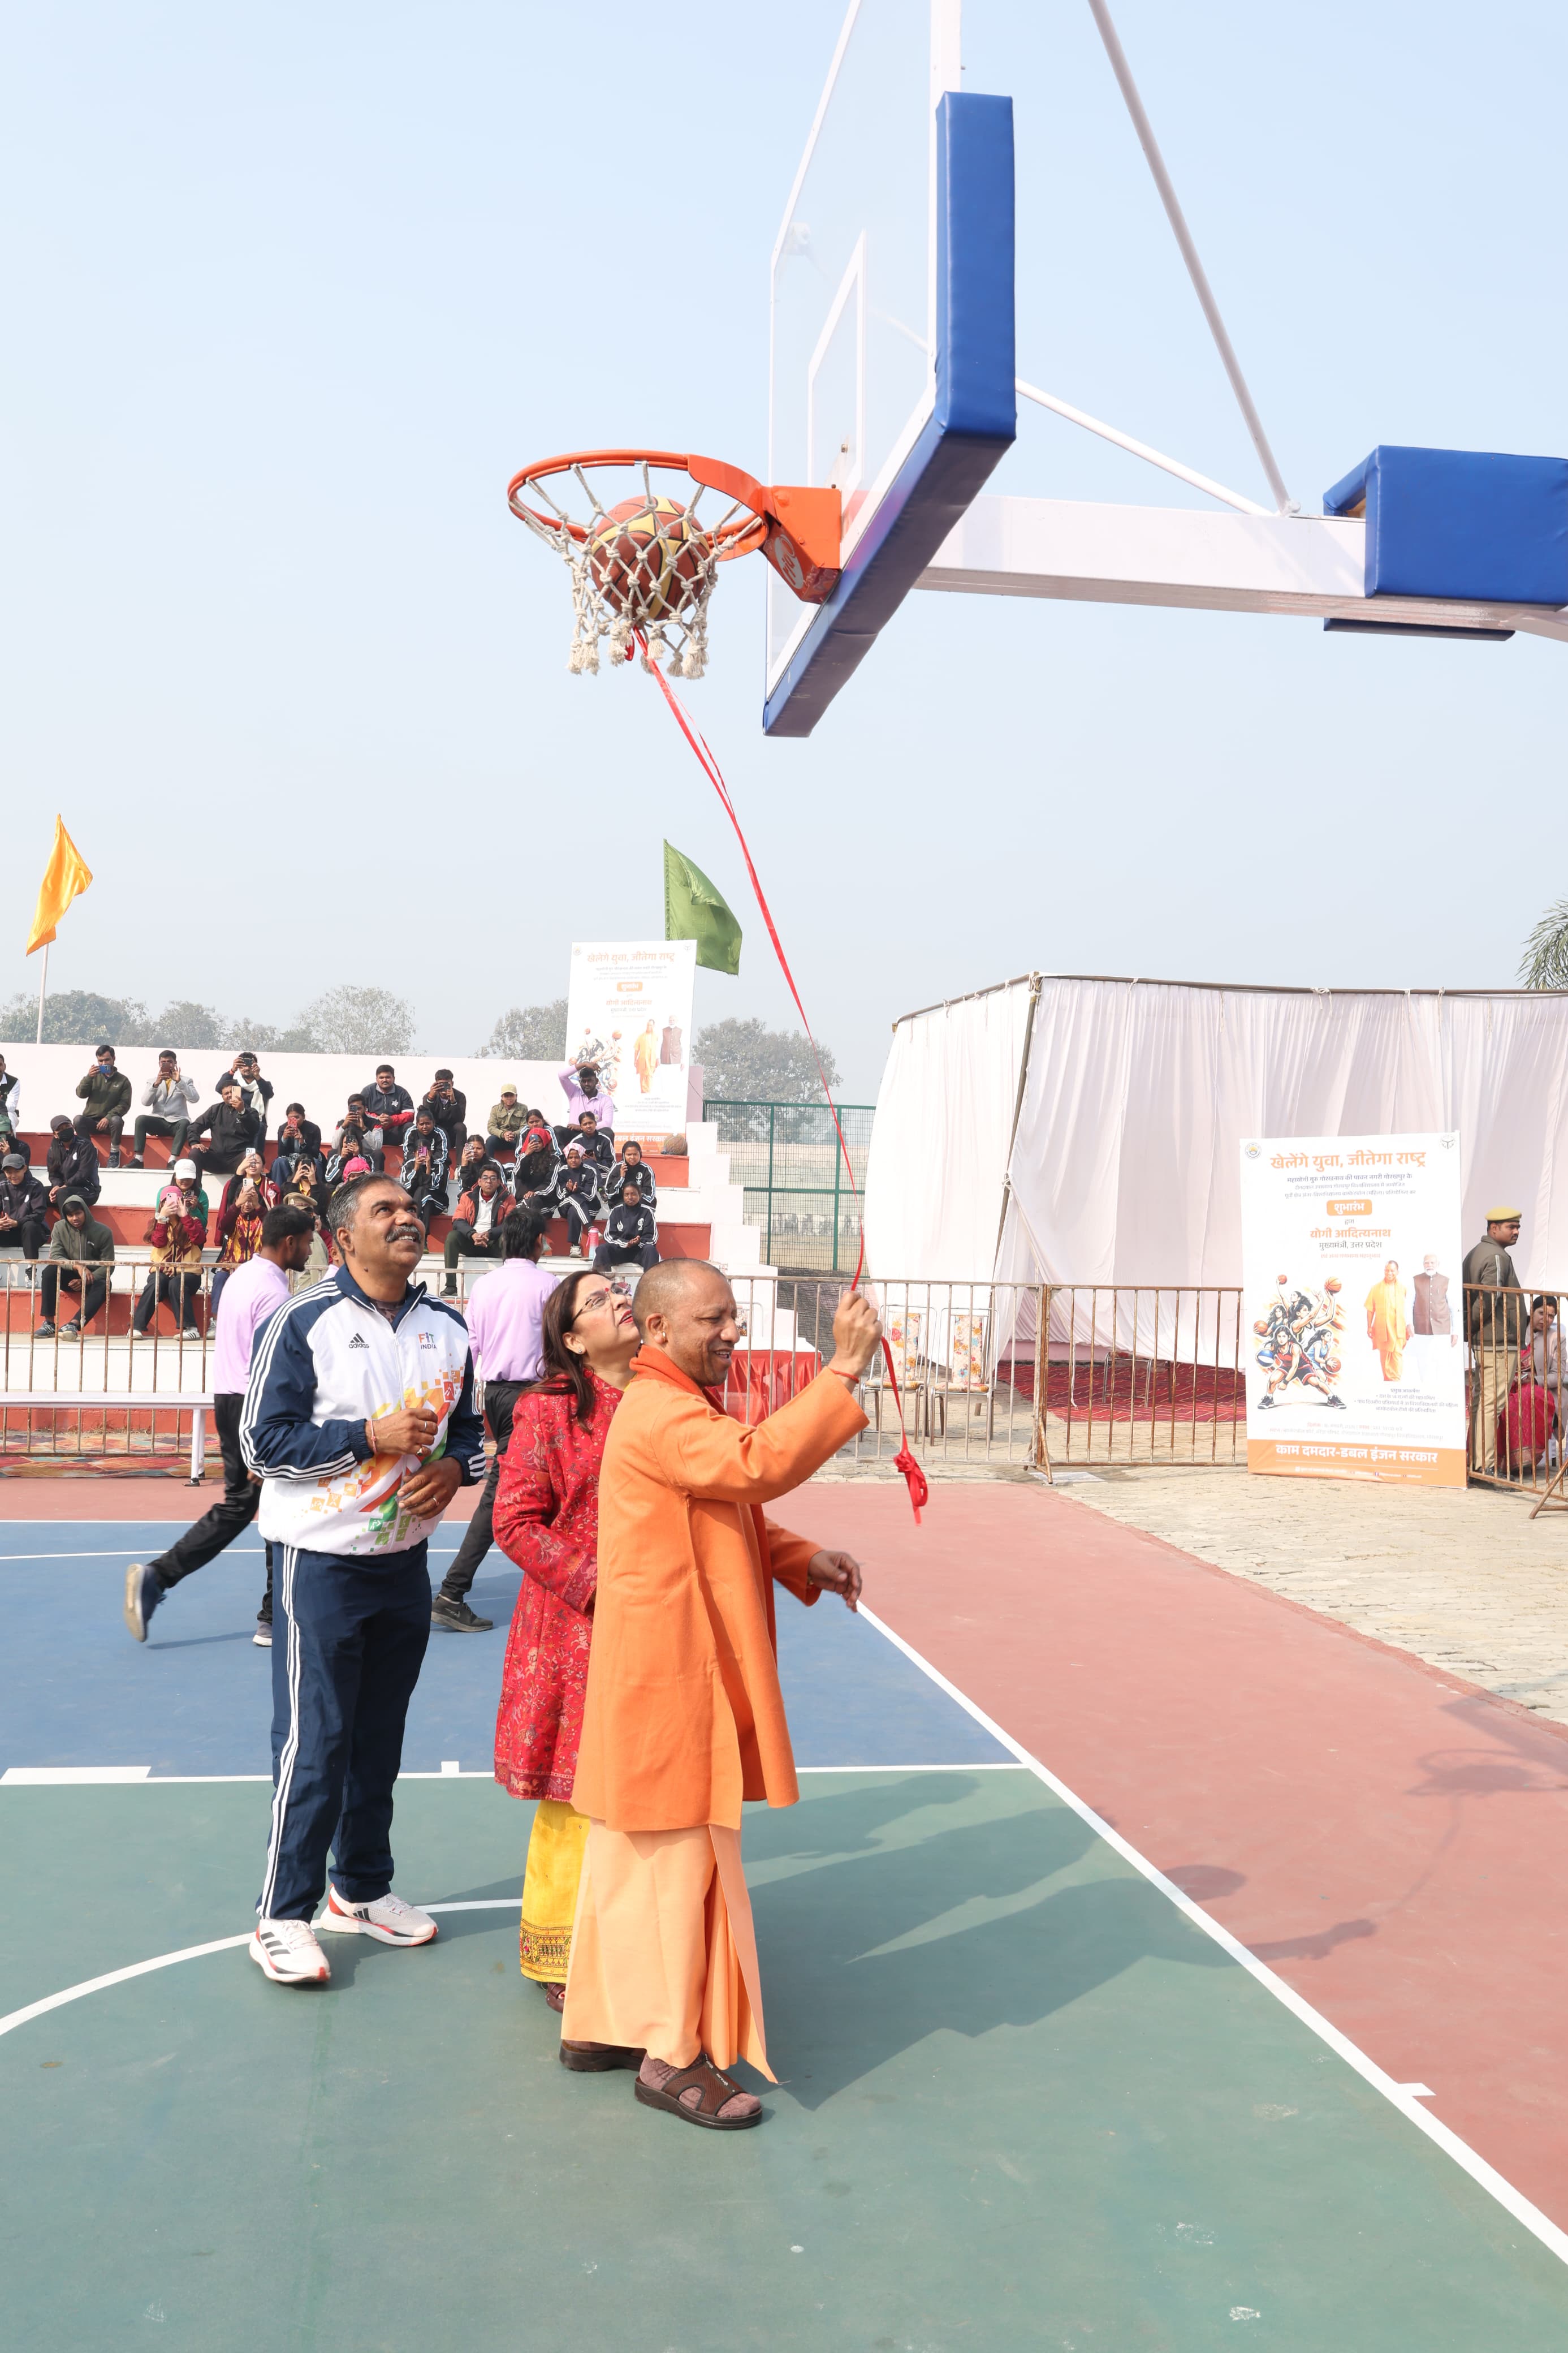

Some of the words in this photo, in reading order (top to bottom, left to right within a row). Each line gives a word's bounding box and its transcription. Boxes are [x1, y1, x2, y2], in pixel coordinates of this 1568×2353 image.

[587, 953, 609, 962] खेलेंगे
[611, 954, 629, 964] युवा,
[631, 951, 656, 961] जीतेगा
[1270, 1153, 1309, 1169] खेलेंगे
[1312, 1155, 1343, 1172] युवा,
[1347, 1149, 1393, 1166] जीतेगा
[1396, 1152, 1426, 1167] राष्ट्र
[1334, 1200, 1364, 1215] शुभारंभ
[1310, 1227, 1332, 1238] योगी
[1334, 1227, 1391, 1239] आदित्यनाथ
[1319, 1240, 1348, 1251] मुख्यमंत्री,
[1365, 1240, 1382, 1249] प्रदेश
[1276, 1444, 1299, 1455] काम
[1302, 1445, 1368, 1459] दमदार-डबल
[1370, 1446, 1397, 1462] इंजन
[1399, 1450, 1438, 1463] सरकार
